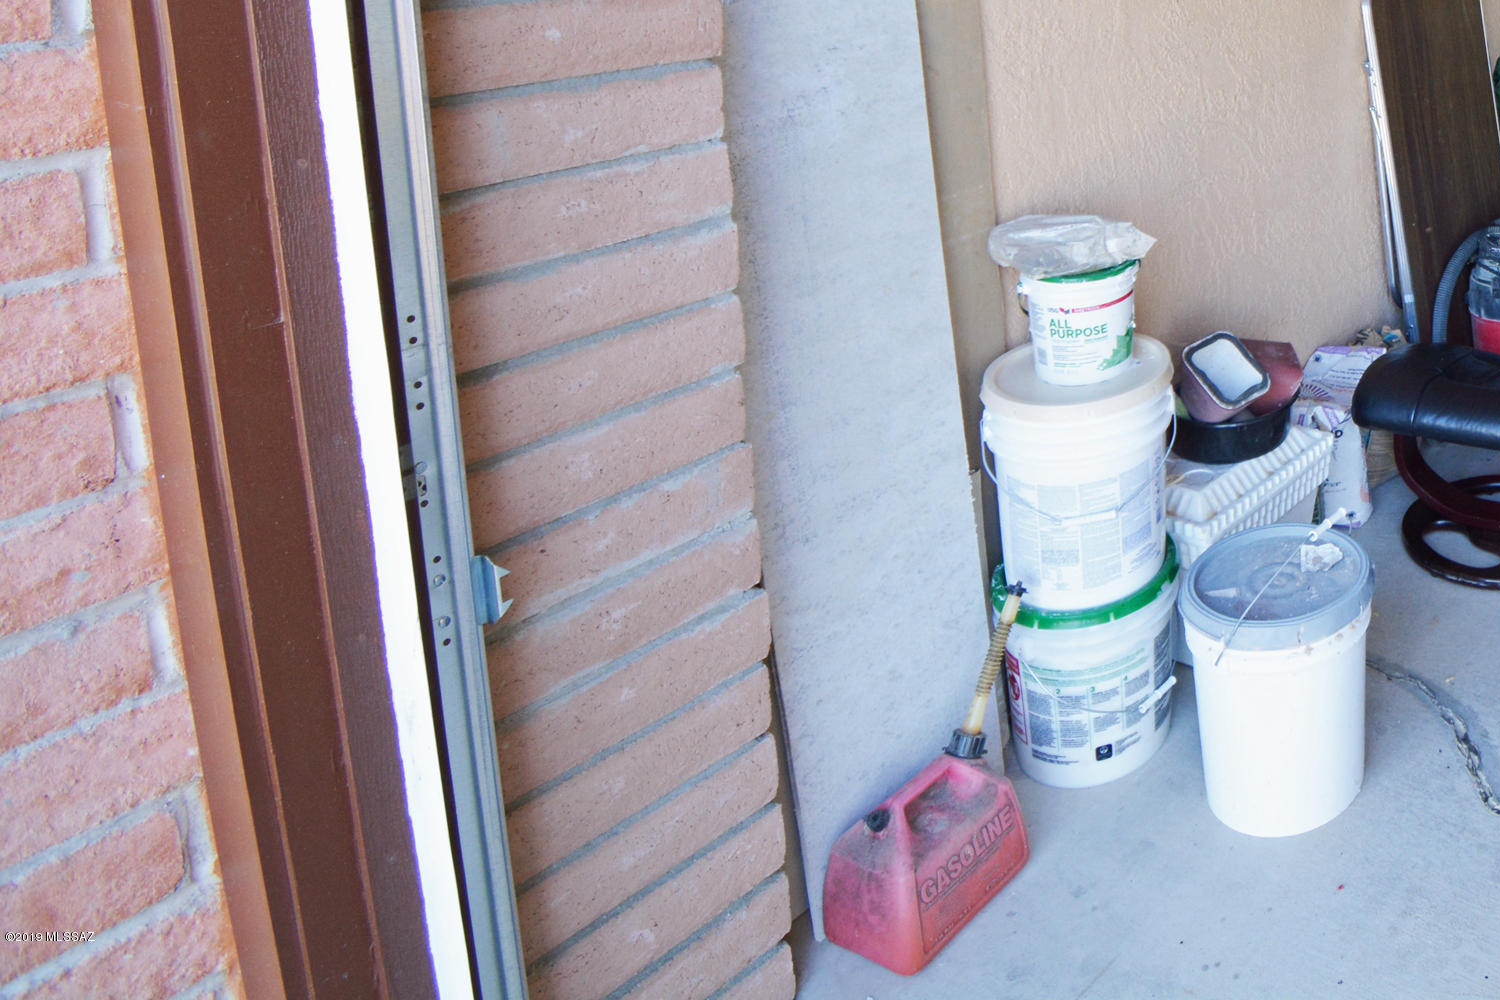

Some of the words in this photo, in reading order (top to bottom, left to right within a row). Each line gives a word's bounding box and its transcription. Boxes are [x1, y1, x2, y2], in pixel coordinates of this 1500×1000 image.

[1049, 318, 1072, 329] ALL
[1050, 322, 1109, 340] PURPOSE
[920, 803, 1015, 905] GASOLINE
